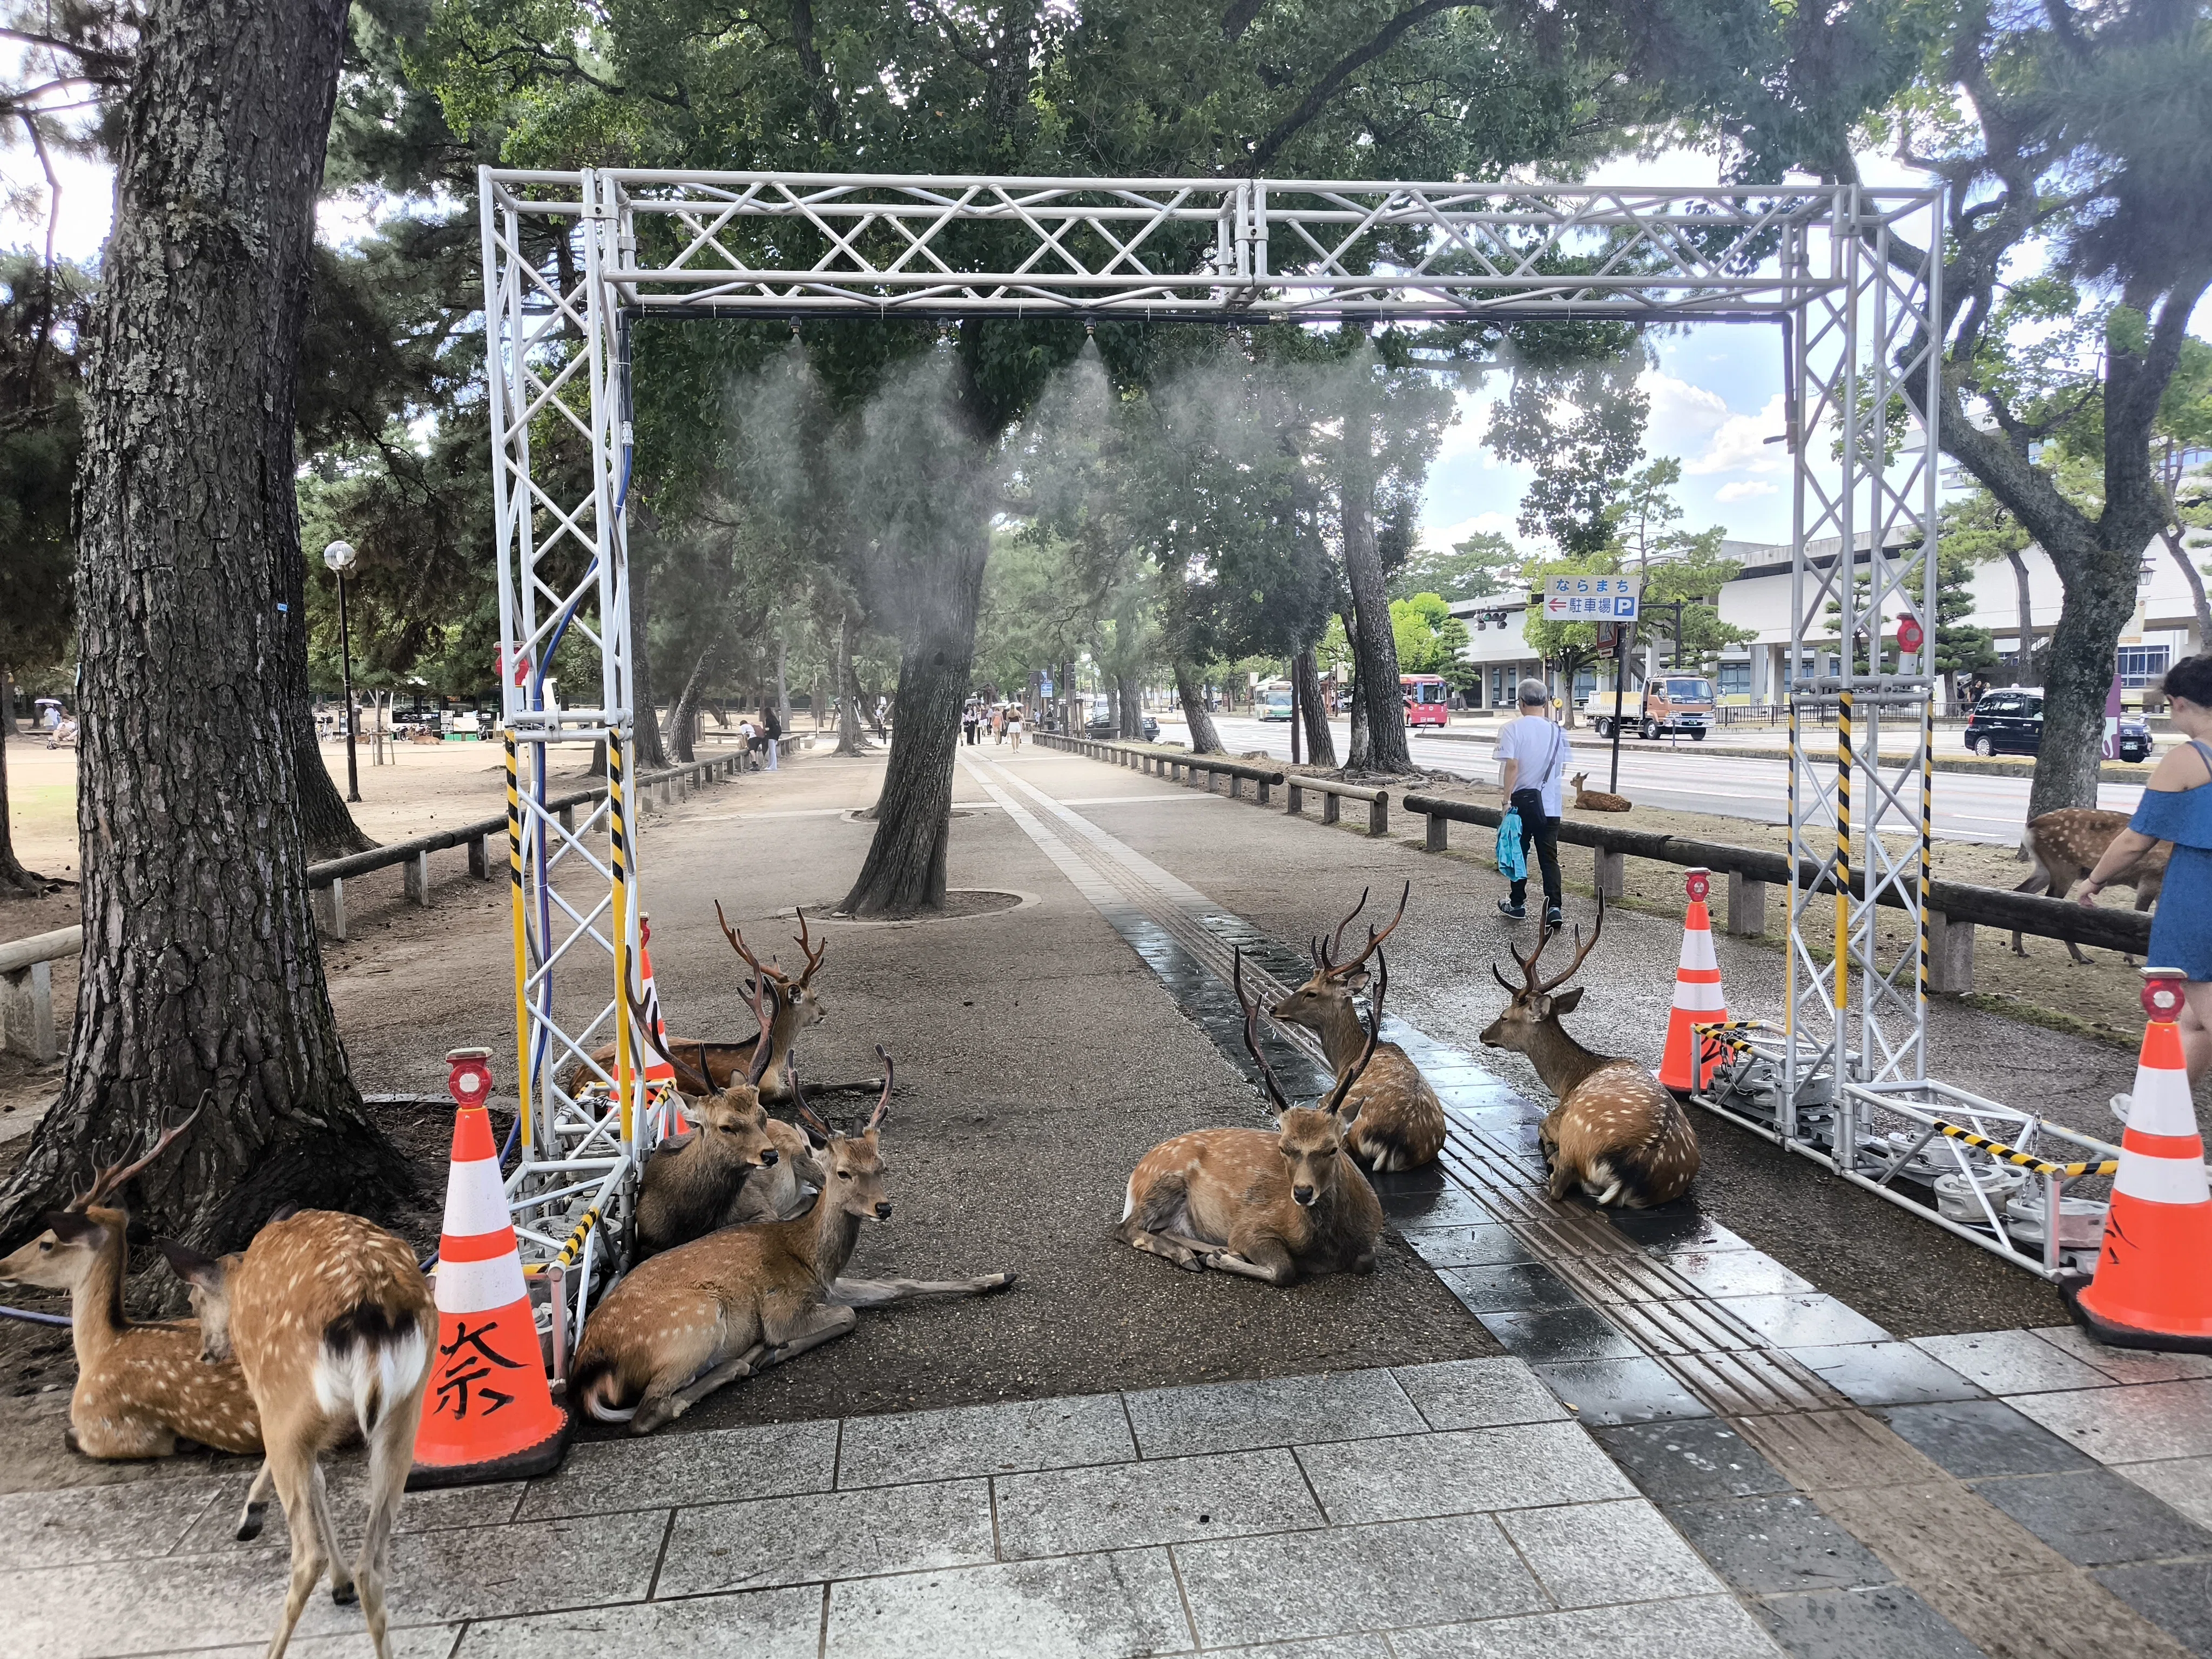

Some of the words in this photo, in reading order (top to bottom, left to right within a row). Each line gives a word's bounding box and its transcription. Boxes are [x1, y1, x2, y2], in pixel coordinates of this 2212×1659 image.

[1556, 578, 1628, 592] ならまち
[1569, 597, 1611, 613] 駐車場
[1617, 598, 1632, 613] P
[430, 1321, 532, 1420] 奈
